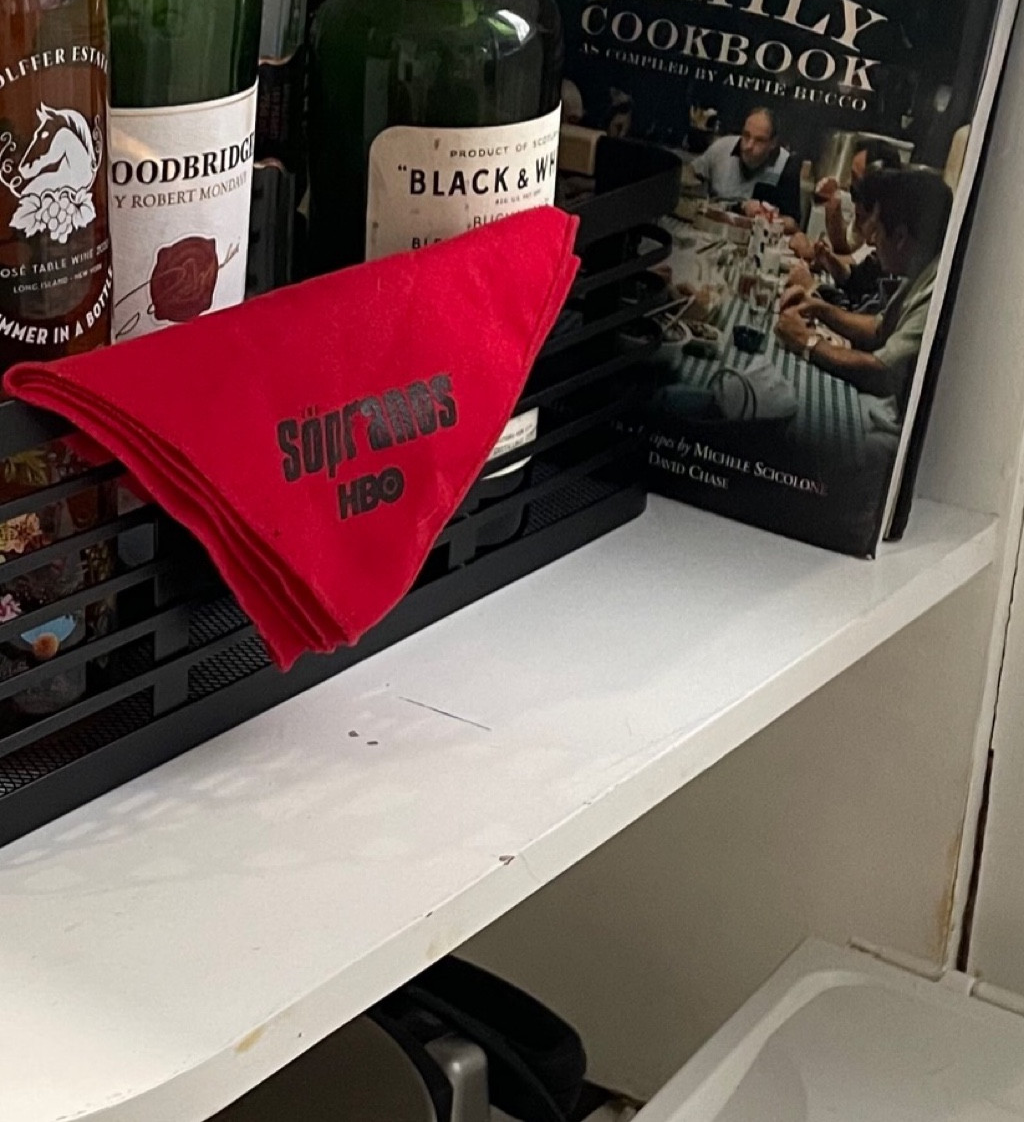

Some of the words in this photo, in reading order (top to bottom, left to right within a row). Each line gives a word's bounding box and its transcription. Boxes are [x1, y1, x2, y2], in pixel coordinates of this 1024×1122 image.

[580, 4, 881, 91] COOKBOOK
[606, 47, 689, 76] COMPILED
[694, 67, 719, 83] BY
[723, 73, 787, 97] ARTIE
[794, 88, 868, 113] BUCCO
[450, 145, 510, 159] PRODUCT
[515, 141, 529, 153] OF
[517, 167, 530, 190] &
[131, 188, 197, 209] ROBERT
[32, 257, 67, 274] TABLE
[53, 325, 70, 345] IN
[75, 319, 84, 337] A
[336, 466, 406, 521] HBO
